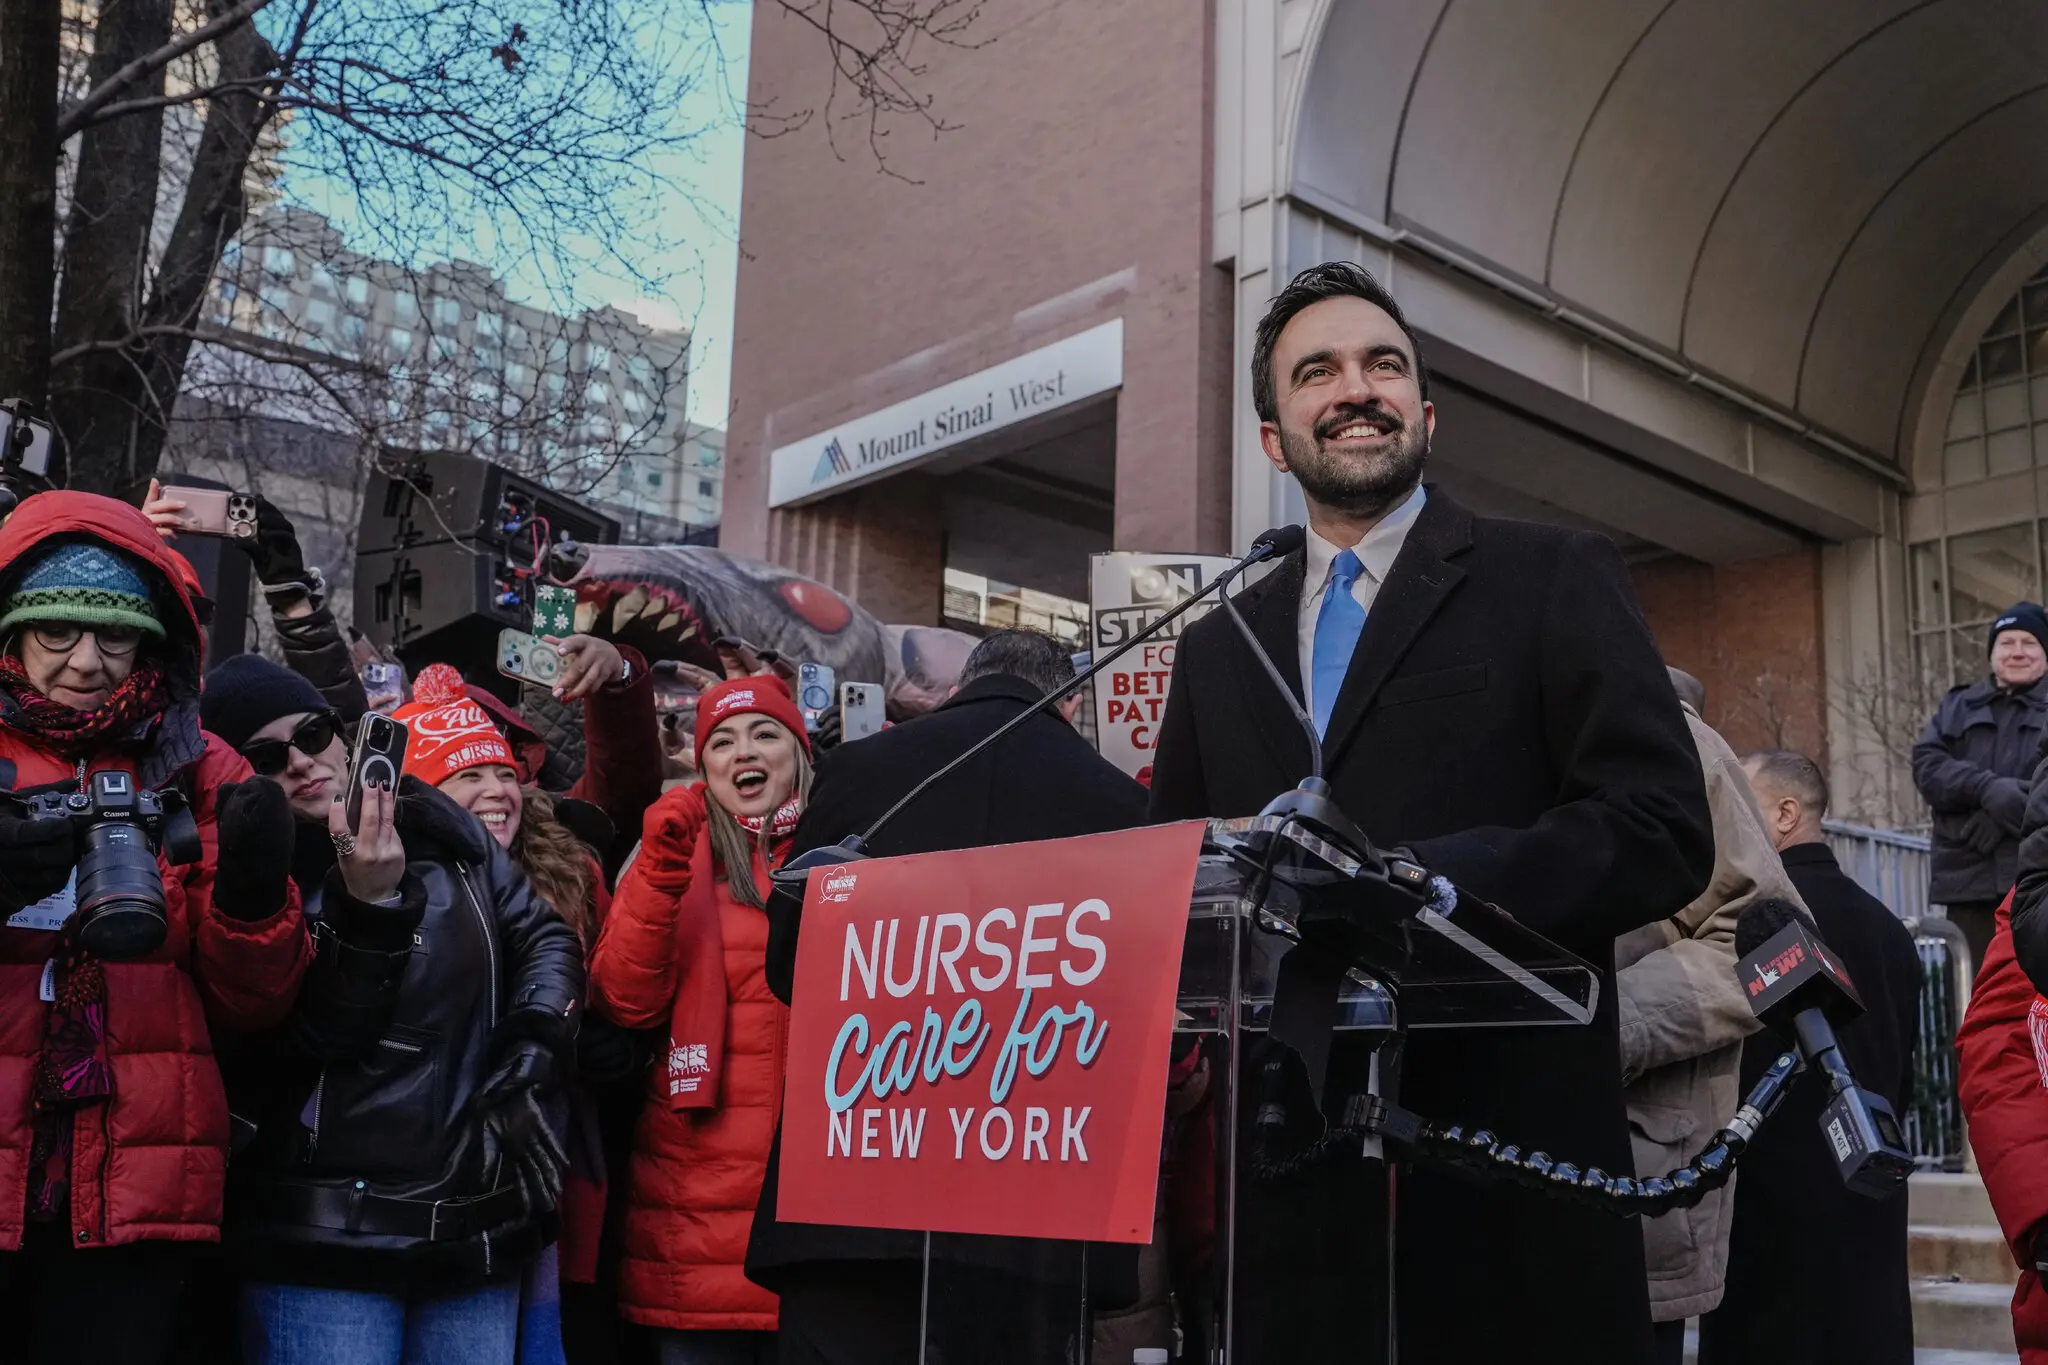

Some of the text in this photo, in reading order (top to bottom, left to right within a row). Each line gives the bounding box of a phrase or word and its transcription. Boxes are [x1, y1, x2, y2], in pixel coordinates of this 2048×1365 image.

[857, 370, 1066, 468] Mount Sinai West
[1135, 567, 1195, 602] ON
[1100, 604, 1214, 644] STRI
[1144, 645, 1176, 667] FO
[1113, 671, 1173, 696] BET
[442, 706, 485, 728] All
[1108, 698, 1167, 723] PAT
[840, 899, 1110, 1001] NURSES
[669, 1049, 707, 1071] RSES
[825, 985, 1108, 1112] Care for
[827, 1106, 1091, 1161] NEW YORK
[1837, 1135, 1847, 1151] KIT
